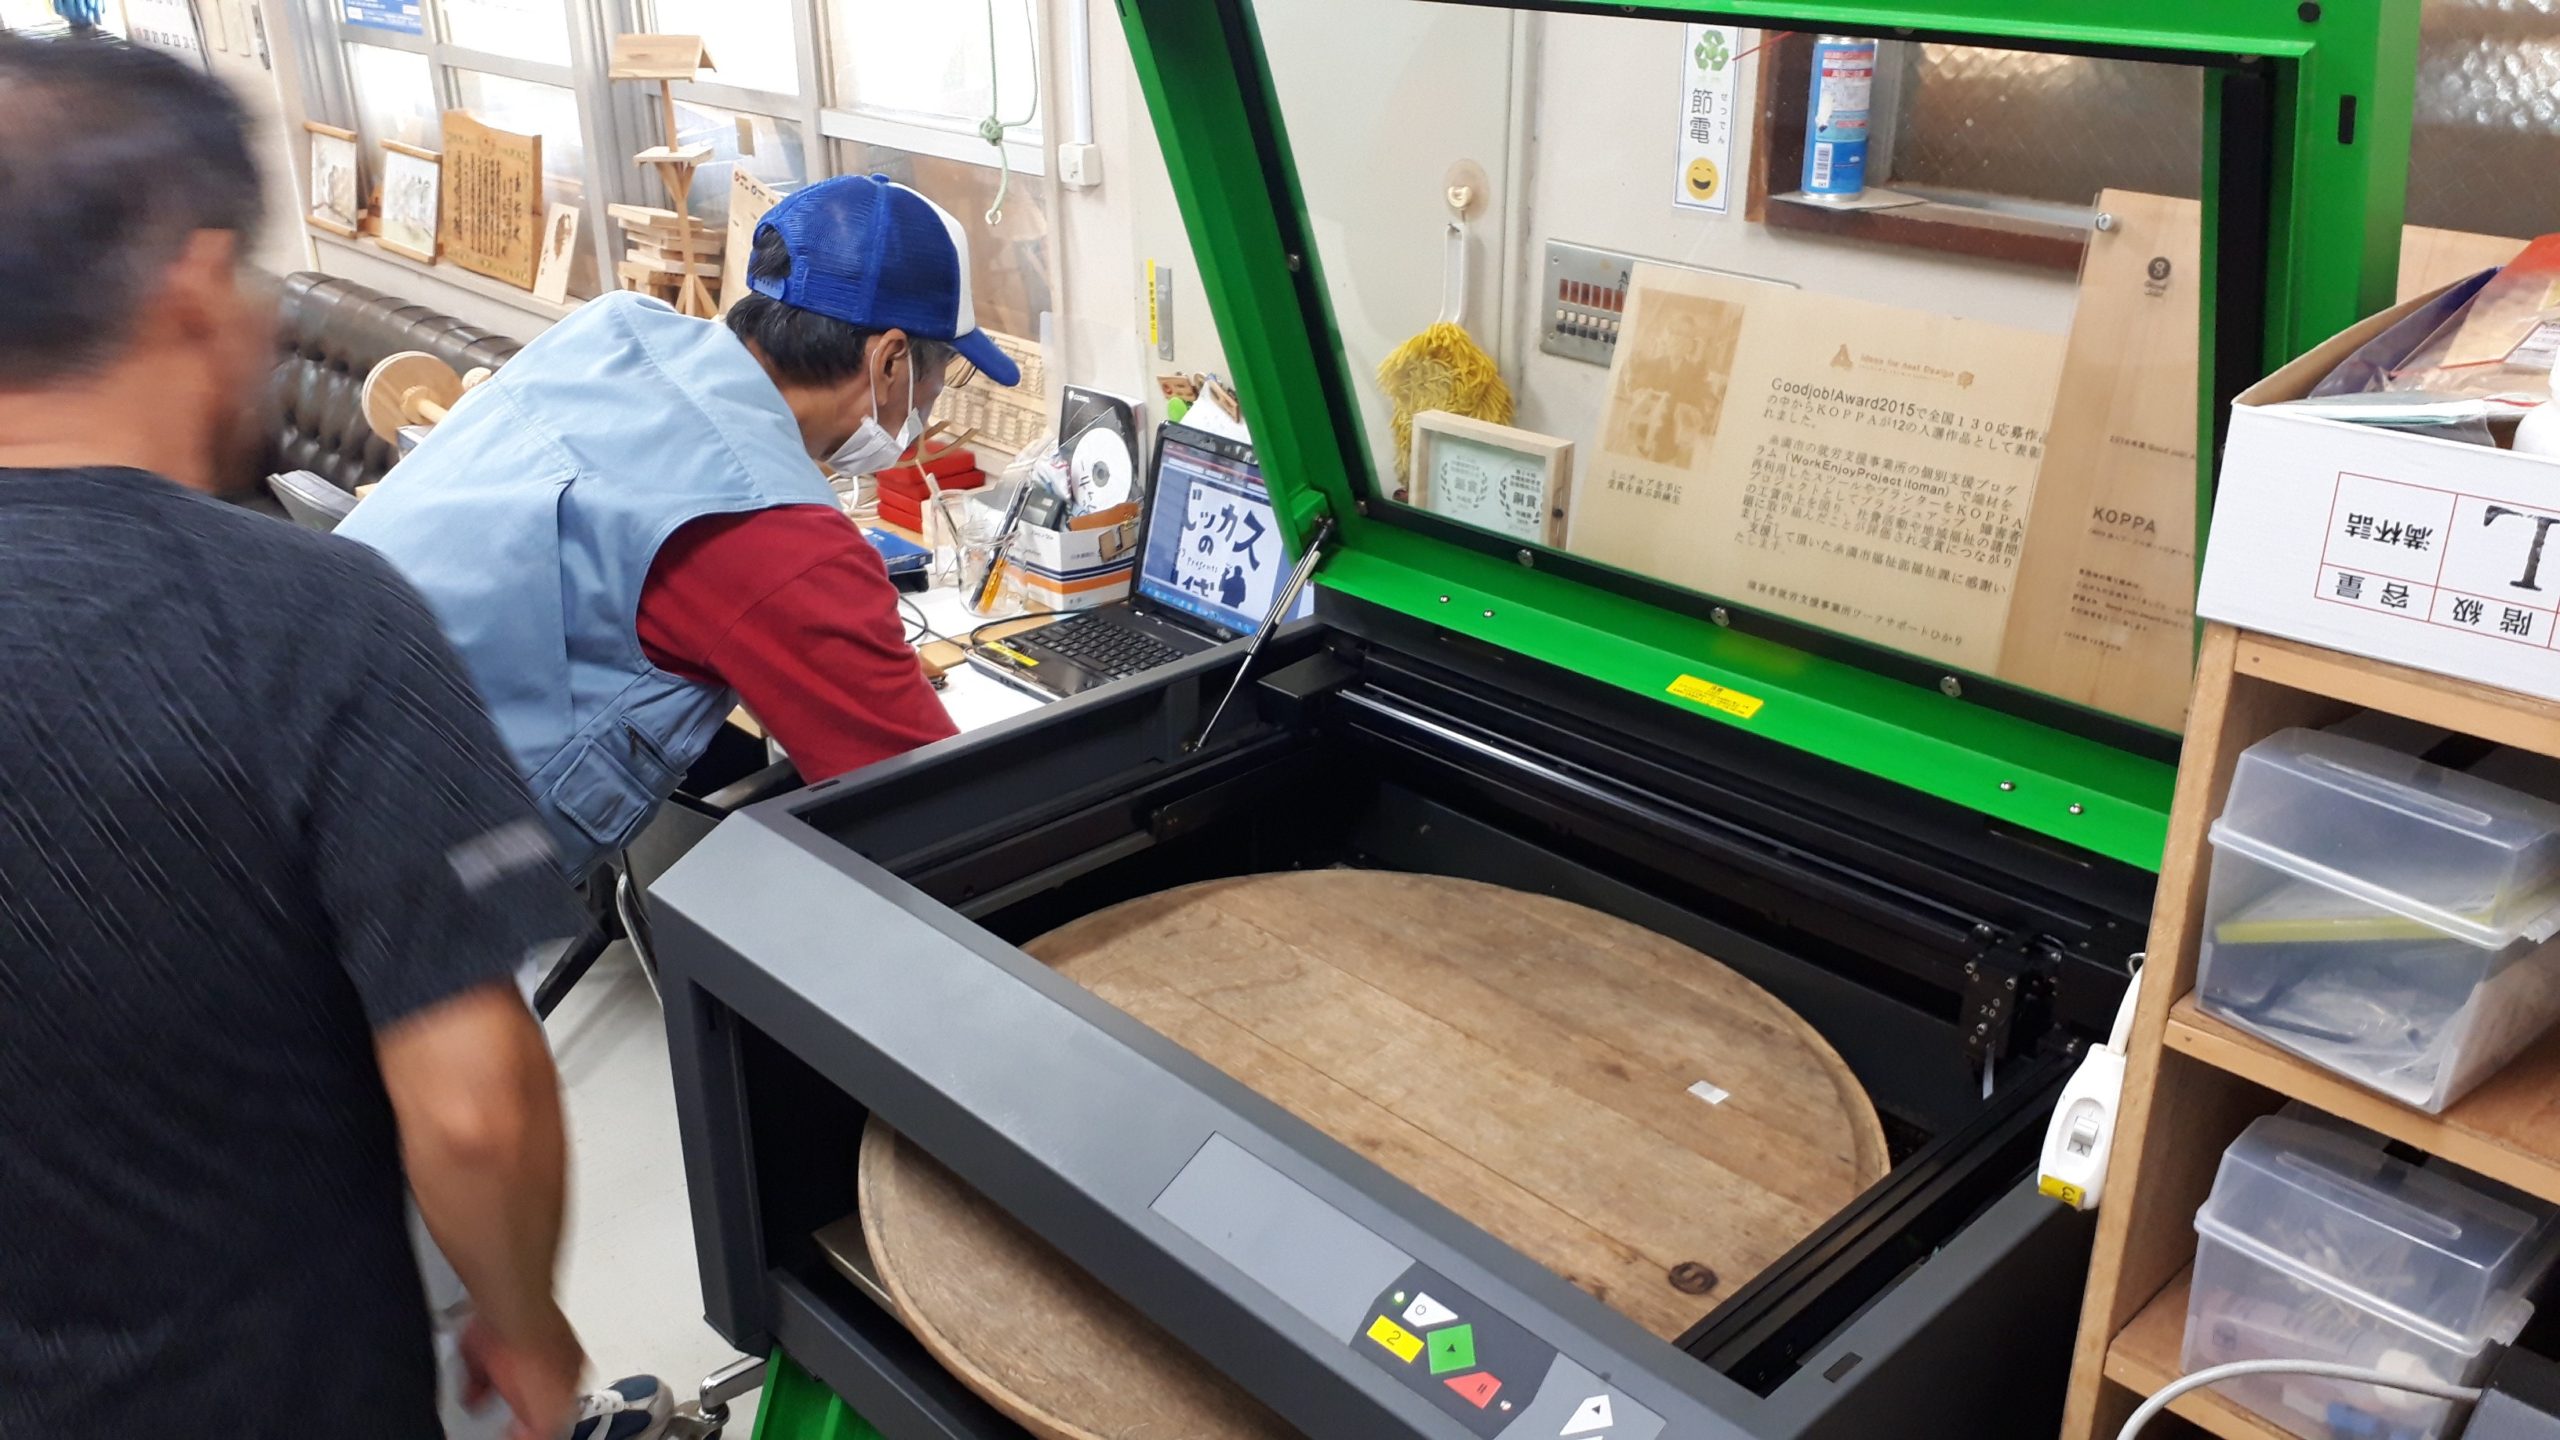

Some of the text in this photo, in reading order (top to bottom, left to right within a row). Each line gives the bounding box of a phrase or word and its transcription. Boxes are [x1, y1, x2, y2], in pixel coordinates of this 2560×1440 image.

[1690, 88, 1713, 144] 節電
[2092, 506, 2156, 533] KOPPA
[2344, 513, 2433, 551] 満杯詰
[2335, 572, 2409, 609] 容量
[2452, 596, 2533, 636] 階級
[1386, 1331, 1401, 1346] 2
